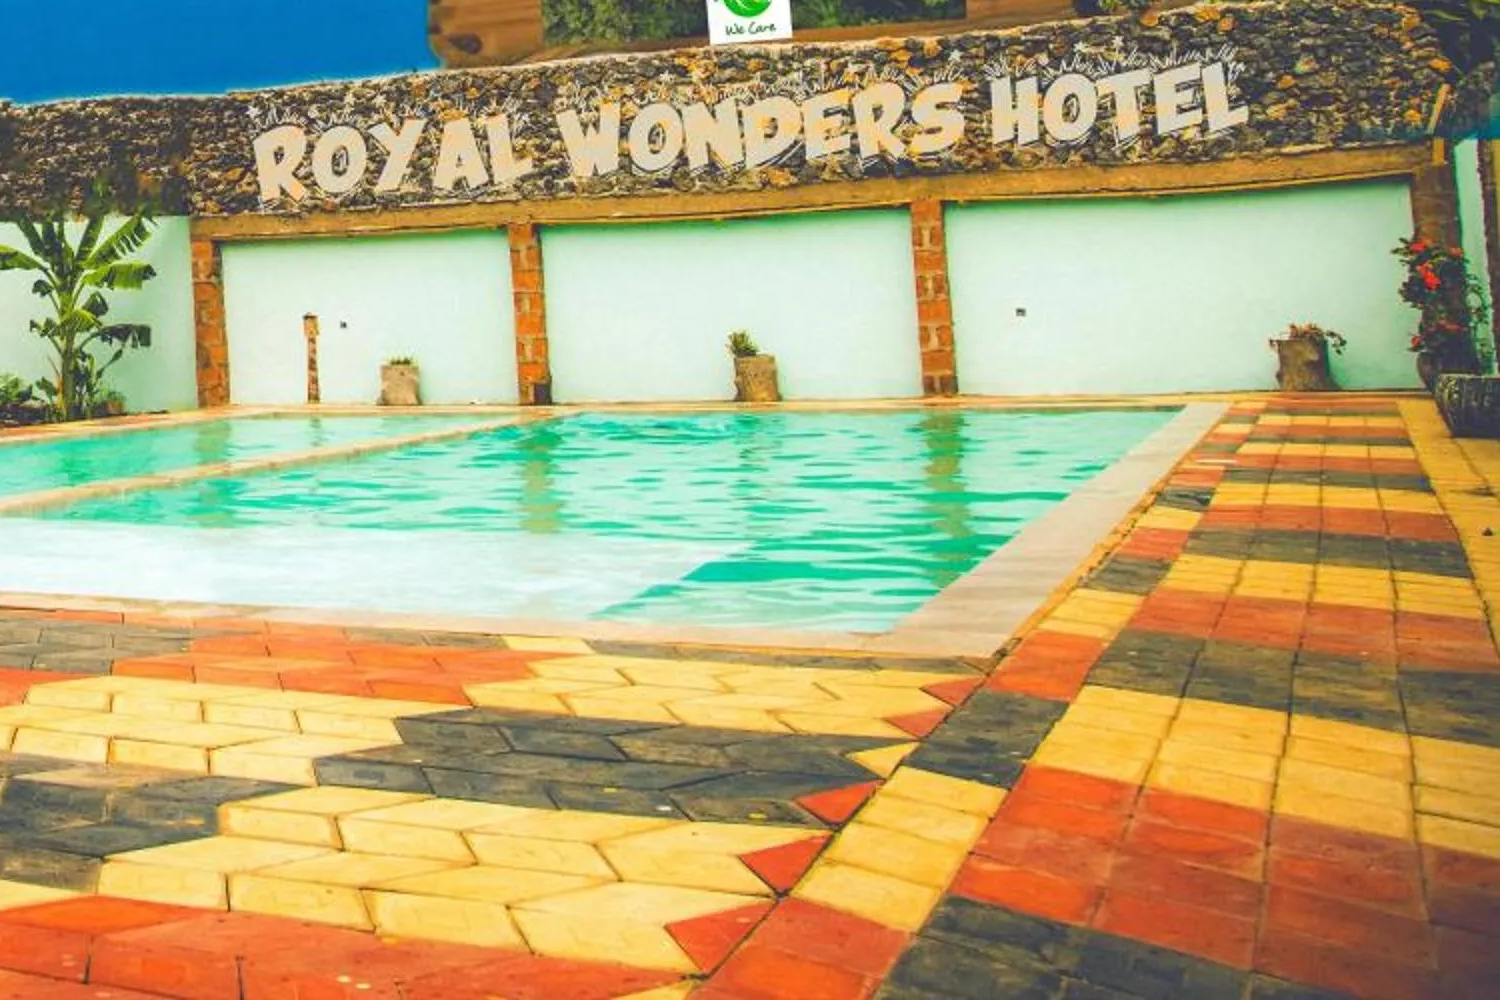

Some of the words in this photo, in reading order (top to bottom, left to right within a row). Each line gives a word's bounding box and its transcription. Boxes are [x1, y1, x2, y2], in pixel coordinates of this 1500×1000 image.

[725, 22, 745, 36] We
[748, 21, 776, 35] Care
[252, 112, 533, 202] ROYAL
[556, 81, 965, 179] WONDERS
[990, 60, 1249, 147] HOTEL
